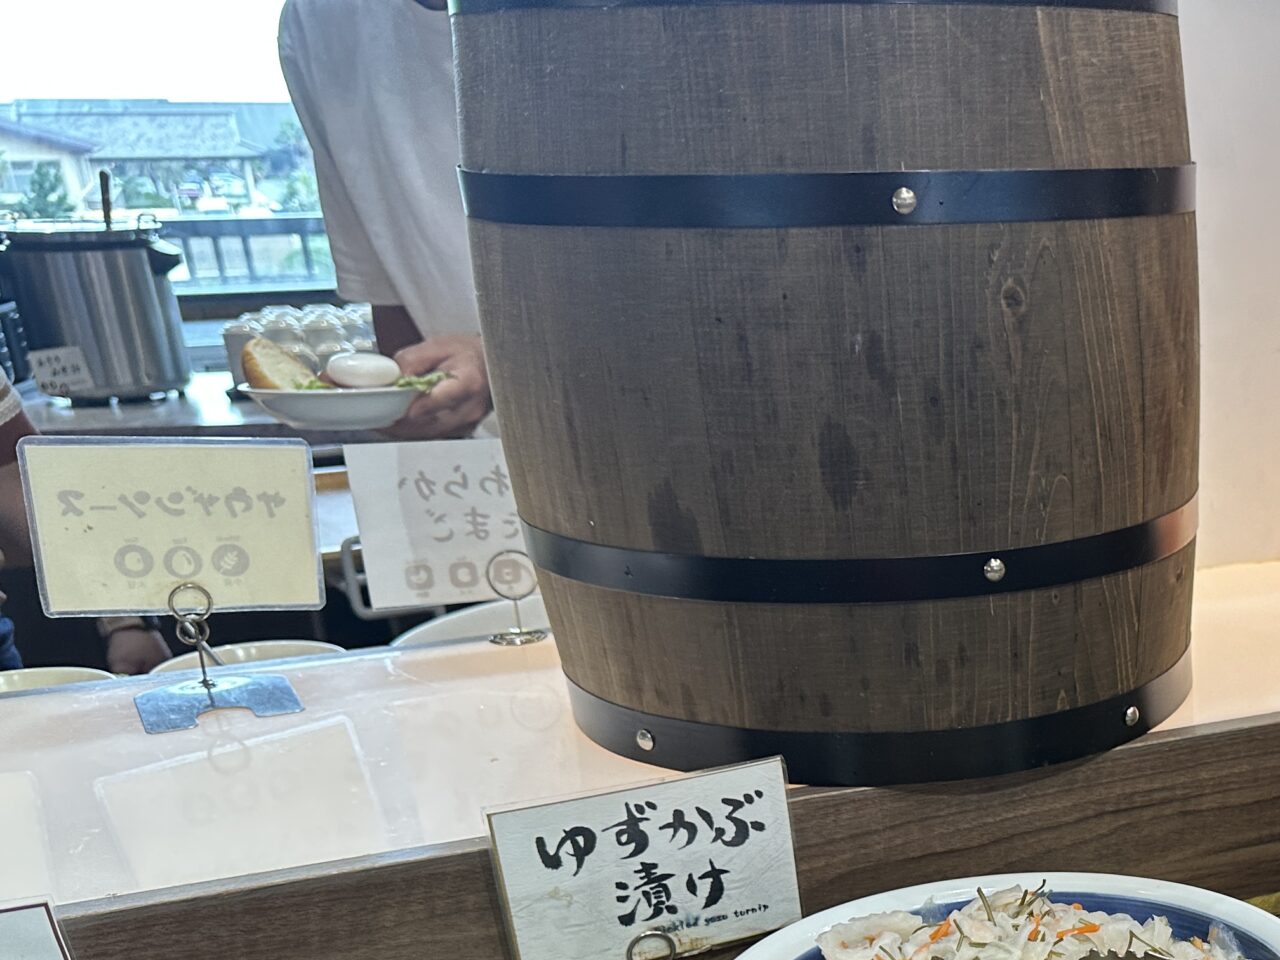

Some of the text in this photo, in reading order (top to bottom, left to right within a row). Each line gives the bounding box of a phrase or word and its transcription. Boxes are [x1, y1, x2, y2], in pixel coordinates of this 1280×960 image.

[535, 790, 766, 876] ゆずかぶ
[615, 858, 731, 926] 漬け
